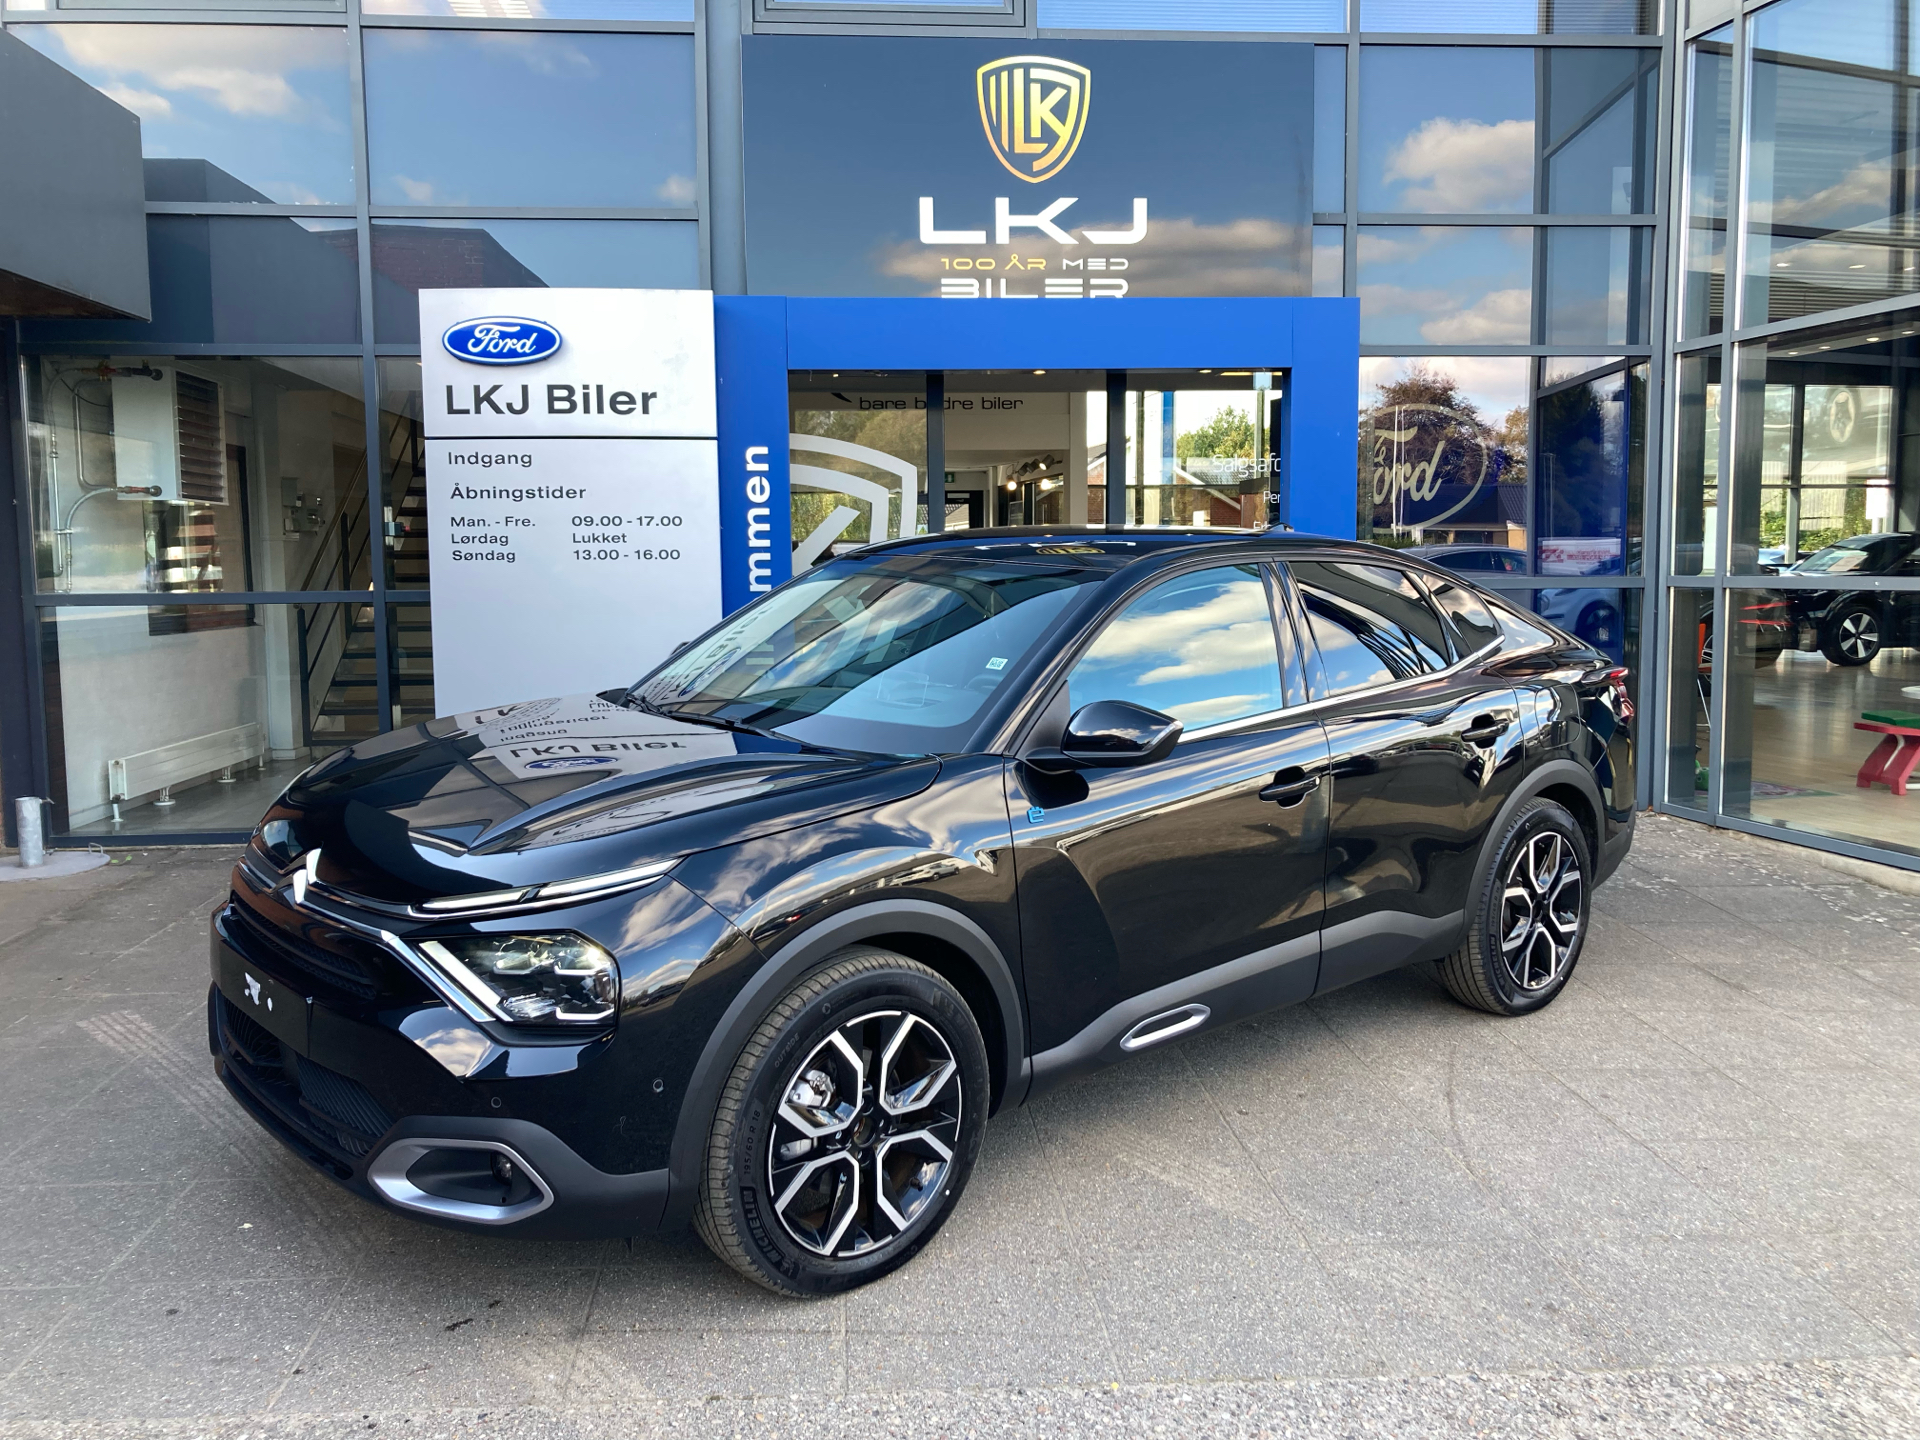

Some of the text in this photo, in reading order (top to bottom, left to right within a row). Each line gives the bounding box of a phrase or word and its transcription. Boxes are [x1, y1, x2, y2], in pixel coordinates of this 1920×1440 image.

[919, 196, 1148, 245] LKJ
[940, 253, 1129, 271] 100 ÅR MED
[940, 278, 1129, 298] BILER
[467, 324, 538, 354] Ford
[445, 384, 658, 415] LKJ Biler
[859, 396, 1024, 410] bare bdre biler
[448, 451, 533, 468] Indgang
[450, 483, 587, 502] Åbningstider
[450, 516, 491, 527] Man.
[505, 516, 536, 527] Fre.
[571, 515, 623, 527] 09.00
[636, 515, 683, 527] 17.00
[450, 532, 628, 547] Lørdag Lukket
[451, 550, 516, 563] Søndag
[573, 549, 620, 561] 13.00
[634, 549, 681, 560] 16.00
[774, 1033, 800, 1069] OUTSIDE
[743, 1109, 762, 1176] 195/60 R 18
[743, 1189, 783, 1266] MICHELIN
